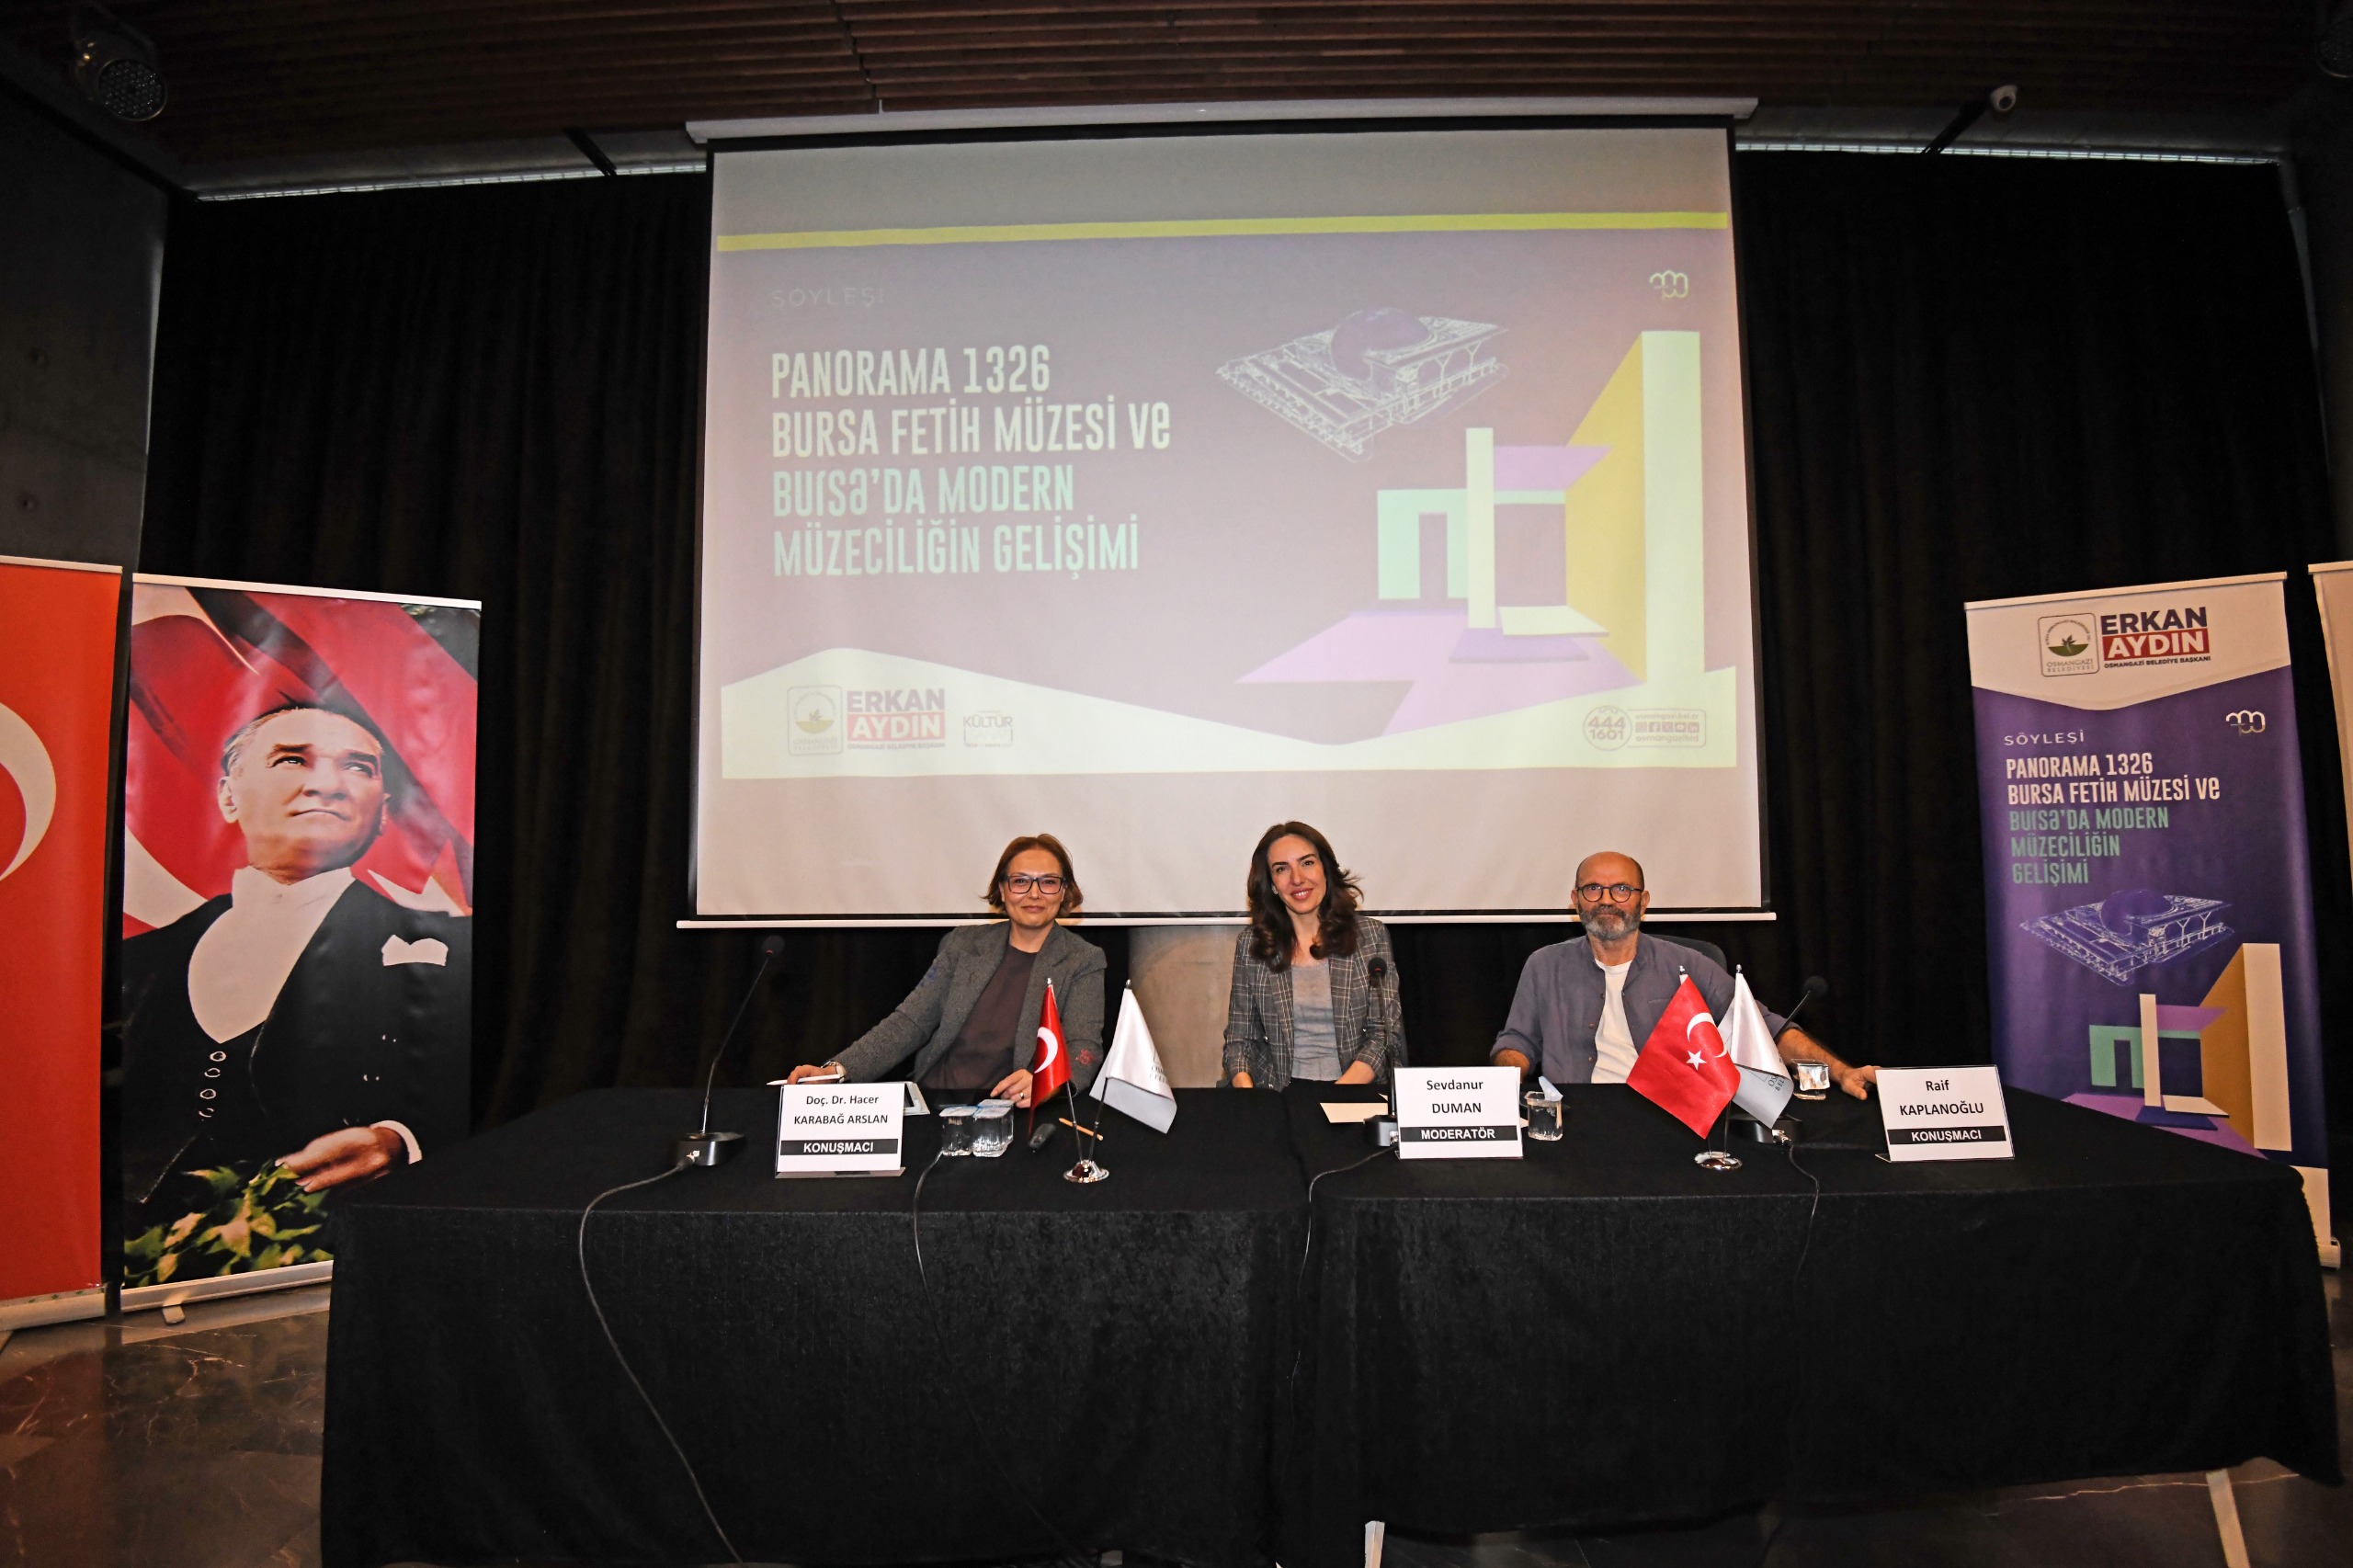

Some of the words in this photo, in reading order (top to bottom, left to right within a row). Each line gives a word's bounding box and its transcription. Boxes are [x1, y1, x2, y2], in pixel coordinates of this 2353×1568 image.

[771, 347, 951, 399] PANORAMA
[963, 345, 1051, 393] 1326
[772, 409, 879, 458] BURSA
[891, 398, 981, 456] FETİH
[994, 395, 1117, 453] MÜZESİ
[938, 464, 1074, 514] MODERN
[774, 518, 981, 577] MÜZECİLİĞİN
[994, 514, 1139, 580] GELİŞİMİ
[2100, 607, 2207, 635] ERKAN
[2107, 631, 2204, 659] AYDIN
[2146, 658, 2178, 666] BELEDİYE
[847, 688, 945, 712] ERKAN
[851, 713, 941, 739] AYDIN
[1587, 716, 1626, 730] 444
[1589, 730, 1624, 741] 1601
[2004, 730, 2085, 745] SÖYLEŞİ
[2006, 755, 2101, 779] PANORAMA
[2106, 752, 2154, 776] 1326
[2007, 783, 2064, 805] BURSA
[2069, 778, 2118, 803] FETİH
[2123, 775, 2190, 801] MÜZESİ
[2096, 806, 2169, 830] MODERN
[2010, 831, 2120, 858] MÜZECİLİĞİN
[2012, 858, 2089, 887] GELİŞİMİ
[1427, 1079, 1483, 1090] Sevdanur
[1925, 1079, 1950, 1092] Raif
[806, 1096, 829, 1107] Doç.
[831, 1096, 847, 1105] Dr.
[849, 1095, 880, 1105] Hacer
[1432, 1102, 1482, 1114] DUMAN
[1899, 1100, 1984, 1116] KAPLANOĞLU
[794, 1113, 845, 1125] KARABAĞ
[847, 1114, 889, 1124] ARSLAN
[1421, 1126, 1495, 1140] MODERATÖR
[1910, 1129, 1983, 1142] KONUŞMACI
[803, 1141, 874, 1154] KONUŞMACI
